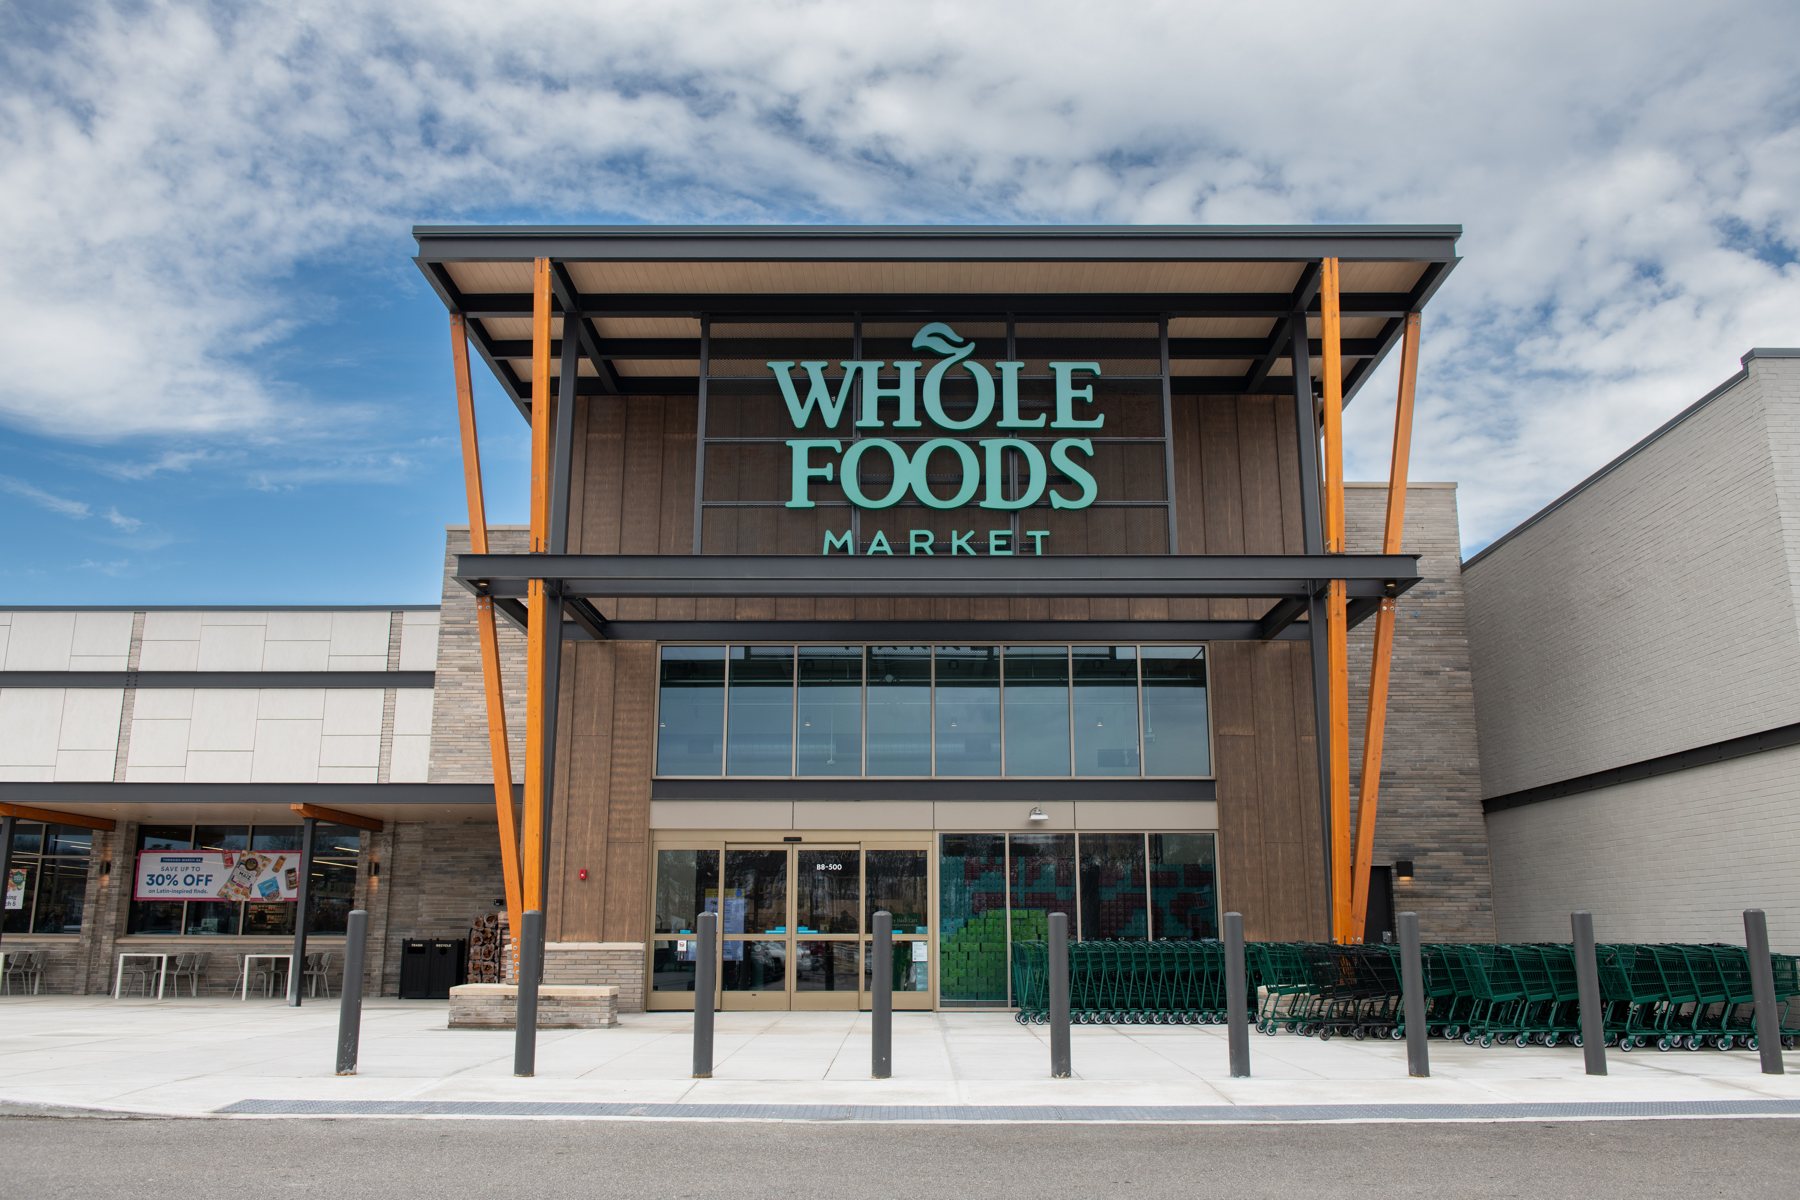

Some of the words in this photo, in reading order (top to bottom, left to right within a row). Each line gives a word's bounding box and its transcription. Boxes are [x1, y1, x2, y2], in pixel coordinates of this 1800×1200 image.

[766, 336, 1105, 431] WHOLE
[784, 437, 1099, 510] FOODS
[822, 528, 1050, 556] MARKET
[146, 873, 179, 886] 30%
[183, 873, 213, 886] OFF
